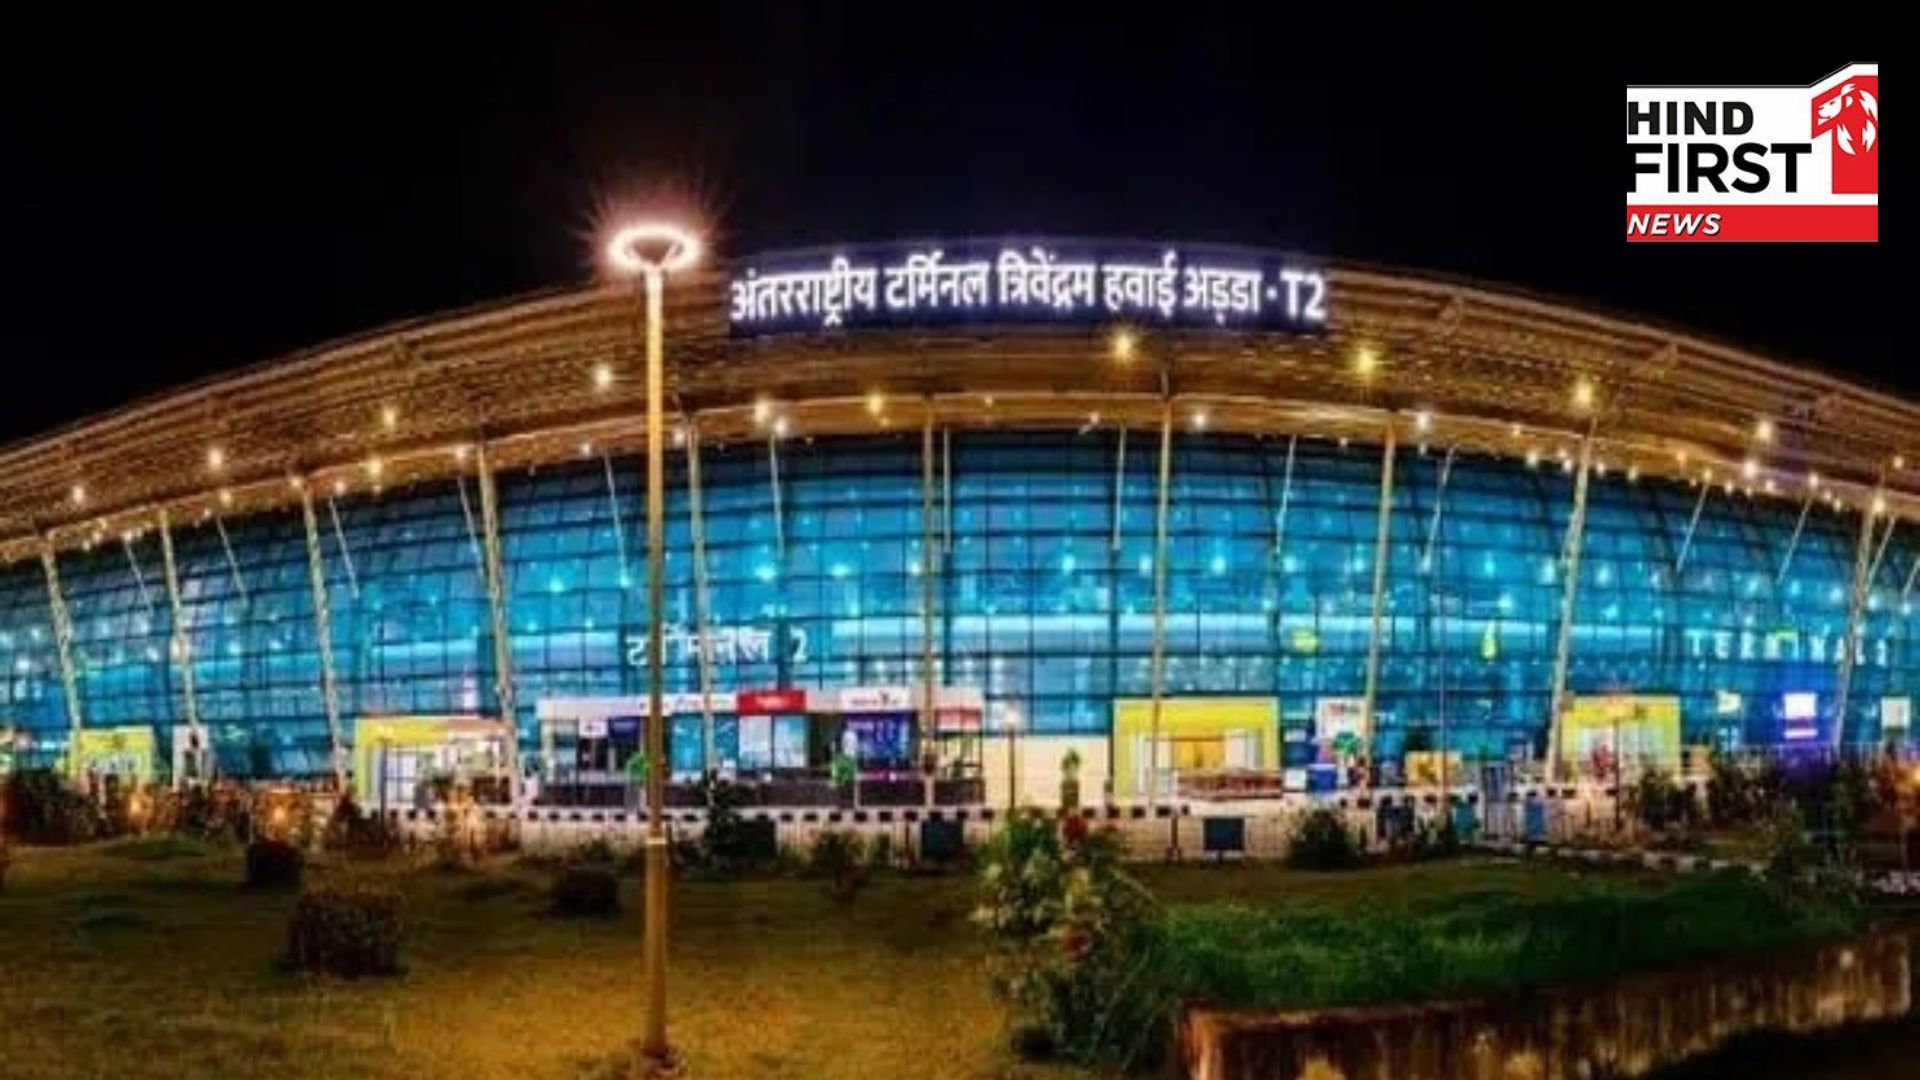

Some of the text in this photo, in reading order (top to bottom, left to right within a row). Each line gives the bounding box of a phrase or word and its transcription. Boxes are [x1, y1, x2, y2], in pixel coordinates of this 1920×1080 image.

[730, 255, 877, 326] अंतरराष्ट्रीय
[884, 250, 989, 308] टर्मिनल
[997, 248, 1097, 310] त्रिवेंद्रम
[1102, 250, 1177, 317] हवाई
